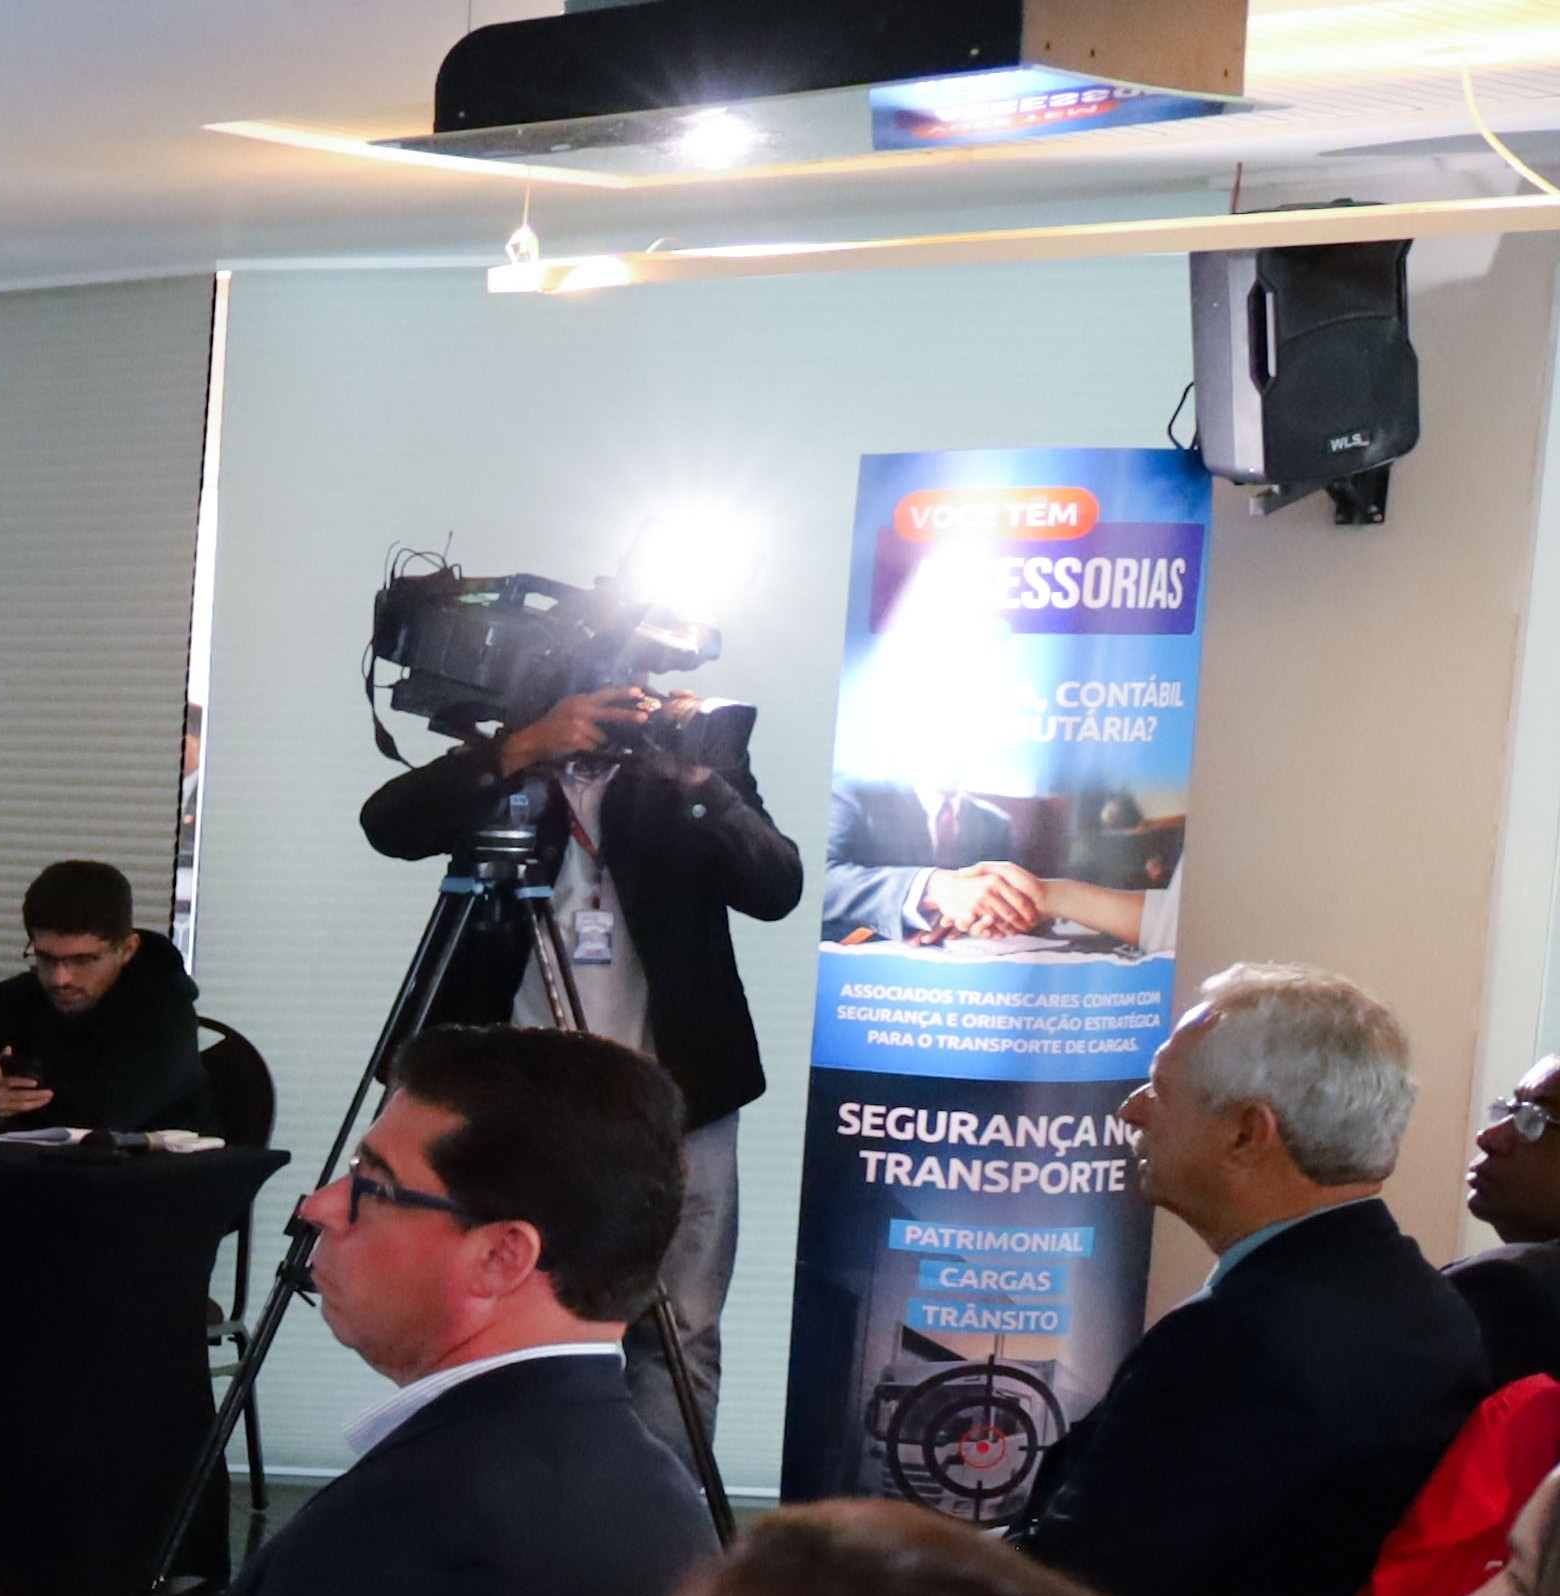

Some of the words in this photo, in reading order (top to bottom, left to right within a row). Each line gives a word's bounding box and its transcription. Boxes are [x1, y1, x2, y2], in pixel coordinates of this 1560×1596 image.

[1054, 674, 1184, 709] CONTÁBIL
[840, 983, 953, 1004] ASSOCIADOS
[956, 989, 1080, 1008] TRANSCARES
[837, 1005, 943, 1028] SEGURANÇA
[946, 1013, 959, 1027] E
[961, 1013, 1081, 1034] ORIENTAÇÃO
[1084, 1012, 1161, 1031] ESTRATÉGICA
[867, 1030, 914, 1047] PARA
[918, 1034, 932, 1048] O
[936, 1034, 1062, 1054] TRANSPORTE
[1064, 1039, 1088, 1054] DE
[837, 1102, 1098, 1157] SEGURANÇA
[859, 1150, 1127, 1194] TRANSPORTE
[905, 1225, 1083, 1252] PATRIMONIAL
[939, 1267, 1052, 1291] CARGAS
[922, 1303, 1058, 1331] TRÂNSITO
